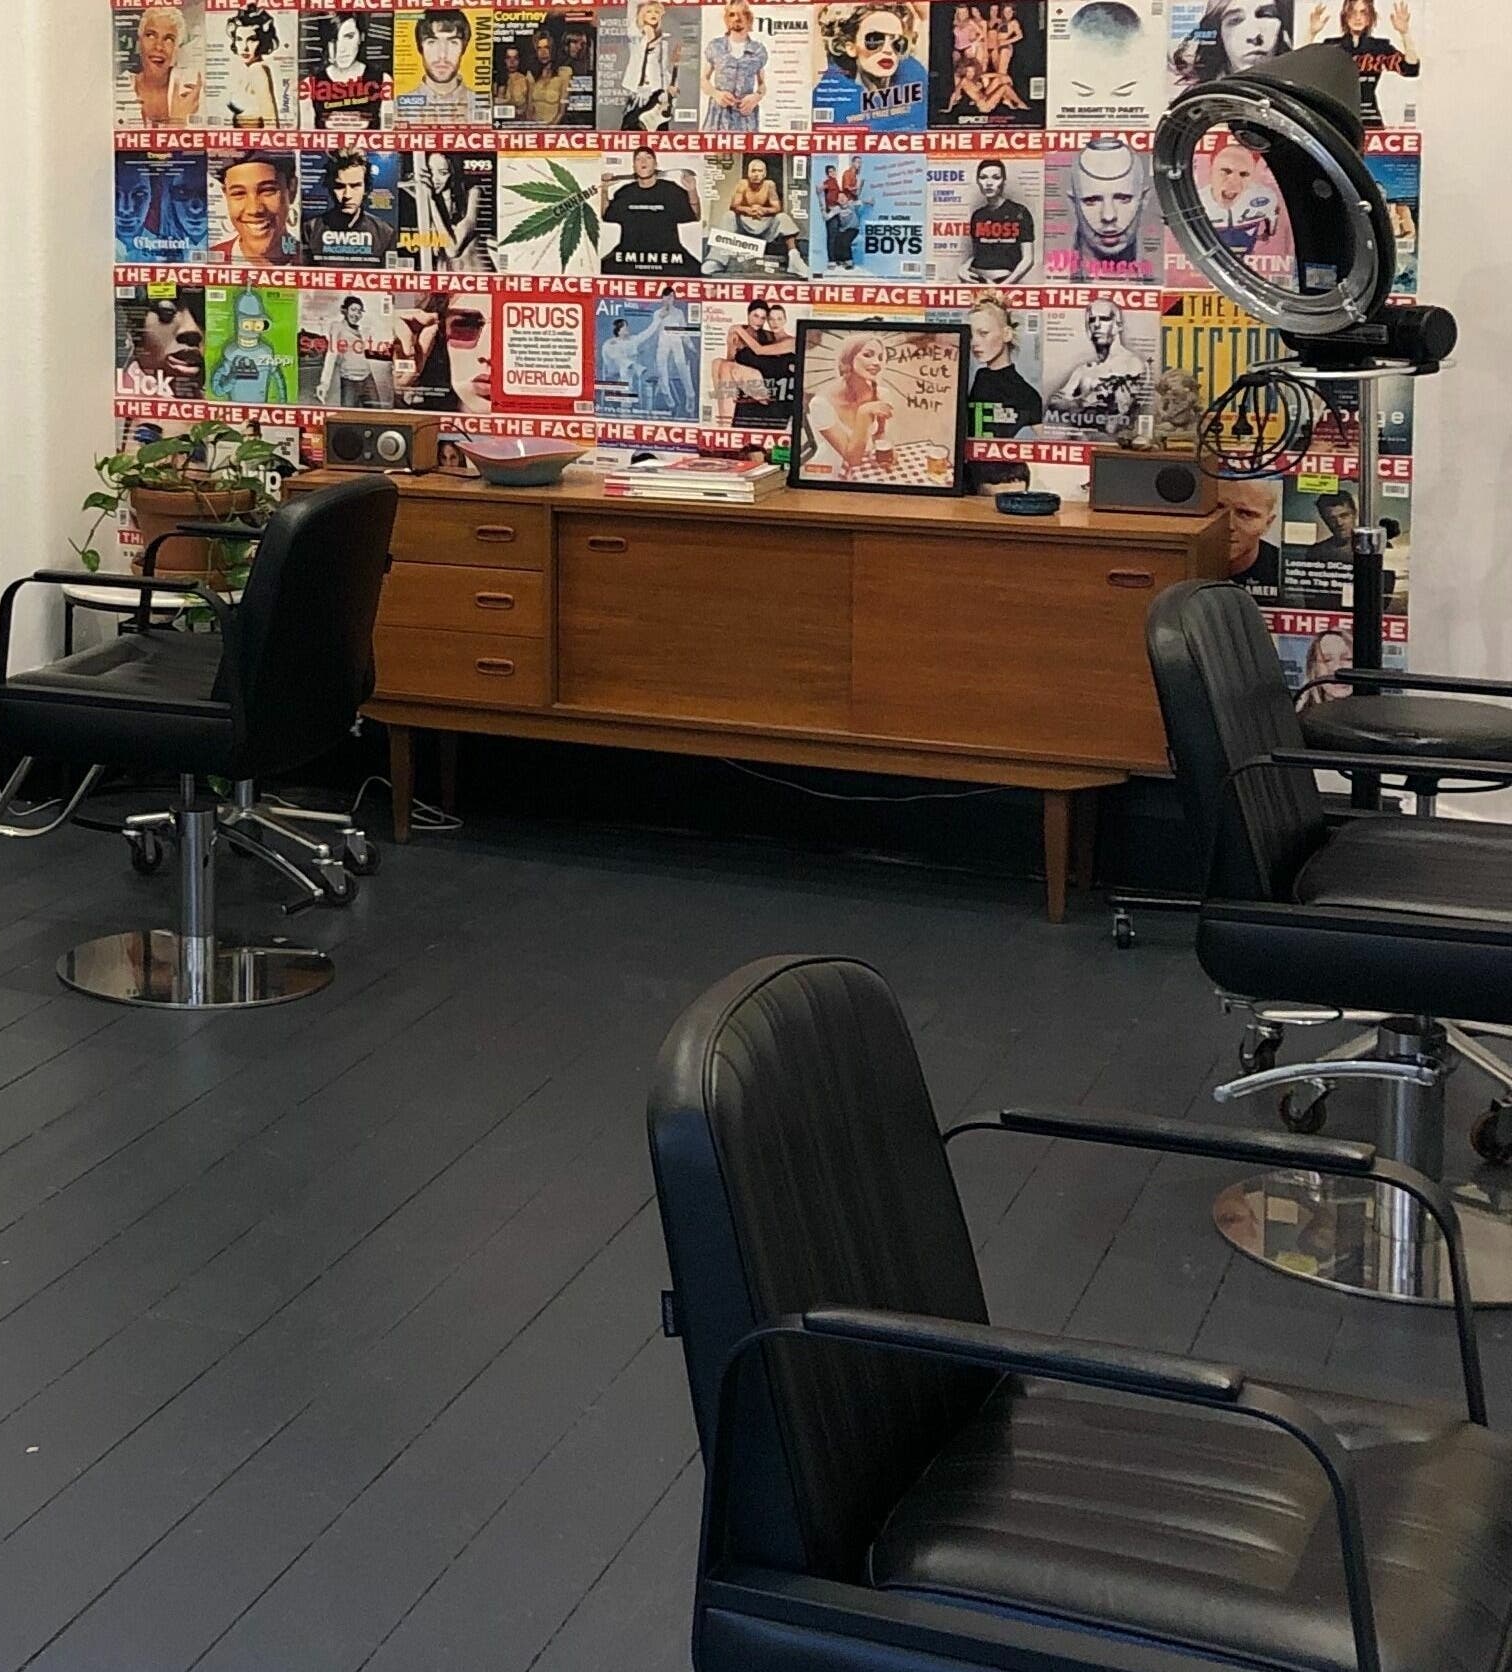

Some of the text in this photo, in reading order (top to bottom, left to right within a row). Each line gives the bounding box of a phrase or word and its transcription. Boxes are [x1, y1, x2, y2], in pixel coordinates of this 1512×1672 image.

[494, 11, 548, 24] Courtney
[475, 17, 491, 51] MAD
[475, 57, 491, 86] FOR
[298, 76, 393, 101] elastica
[862, 82, 923, 111] KYLIE
[115, 132, 204, 148] THE FACE
[207, 132, 298, 149] THE FACE
[301, 132, 394, 149] THE FACE
[397, 132, 495, 150] THE FACE
[499, 133, 598, 150] THE FACE
[601, 134, 700, 152] THE FACE
[703, 134, 810, 152] THE FACE
[813, 134, 925, 152] THE FACE
[926, 133, 1042, 150] THE FACE
[1366, 134, 1418, 152] ACE
[463, 159, 493, 171] 1993
[926, 170, 965, 182] SUEDE
[553, 185, 598, 217] CANNABIS
[865, 225, 923, 237] BEASTIE
[933, 221, 1020, 237] KATE MOSS
[322, 230, 373, 247] ewan
[715, 234, 759, 252] eminem
[865, 236, 923, 254] BOYS
[615, 251, 684, 264] EMINEM
[115, 267, 202, 283] THE FACE
[207, 268, 244, 285] THE
[300, 271, 392, 289] THE FACE
[394, 273, 488, 292] THE FACE
[493, 276, 592, 293] THE FACE
[598, 280, 637, 297] THE
[702, 282, 808, 300] THE FACE
[812, 284, 921, 305] THE FACE
[925, 289, 972, 306] THE
[1047, 290, 1090, 307] THE
[596, 299, 622, 317] Air
[1188, 296, 1225, 317] THE
[507, 306, 580, 329] DRUGS
[117, 366, 175, 397] Lick
[506, 370, 580, 386] OVERLOAD
[116, 401, 206, 419] THE FACE
[248, 407, 297, 425] FACE
[301, 410, 337, 426] TH
[439, 417, 490, 433] FACE
[492, 419, 596, 439] THE FACE
[596, 423, 699, 444] THE FACE
[700, 431, 744, 449] THE
[750, 435, 792, 451] FAC
[973, 442, 1034, 460] FACE
[1037, 444, 1084, 463] THE
[1281, 614, 1331, 634] THE
